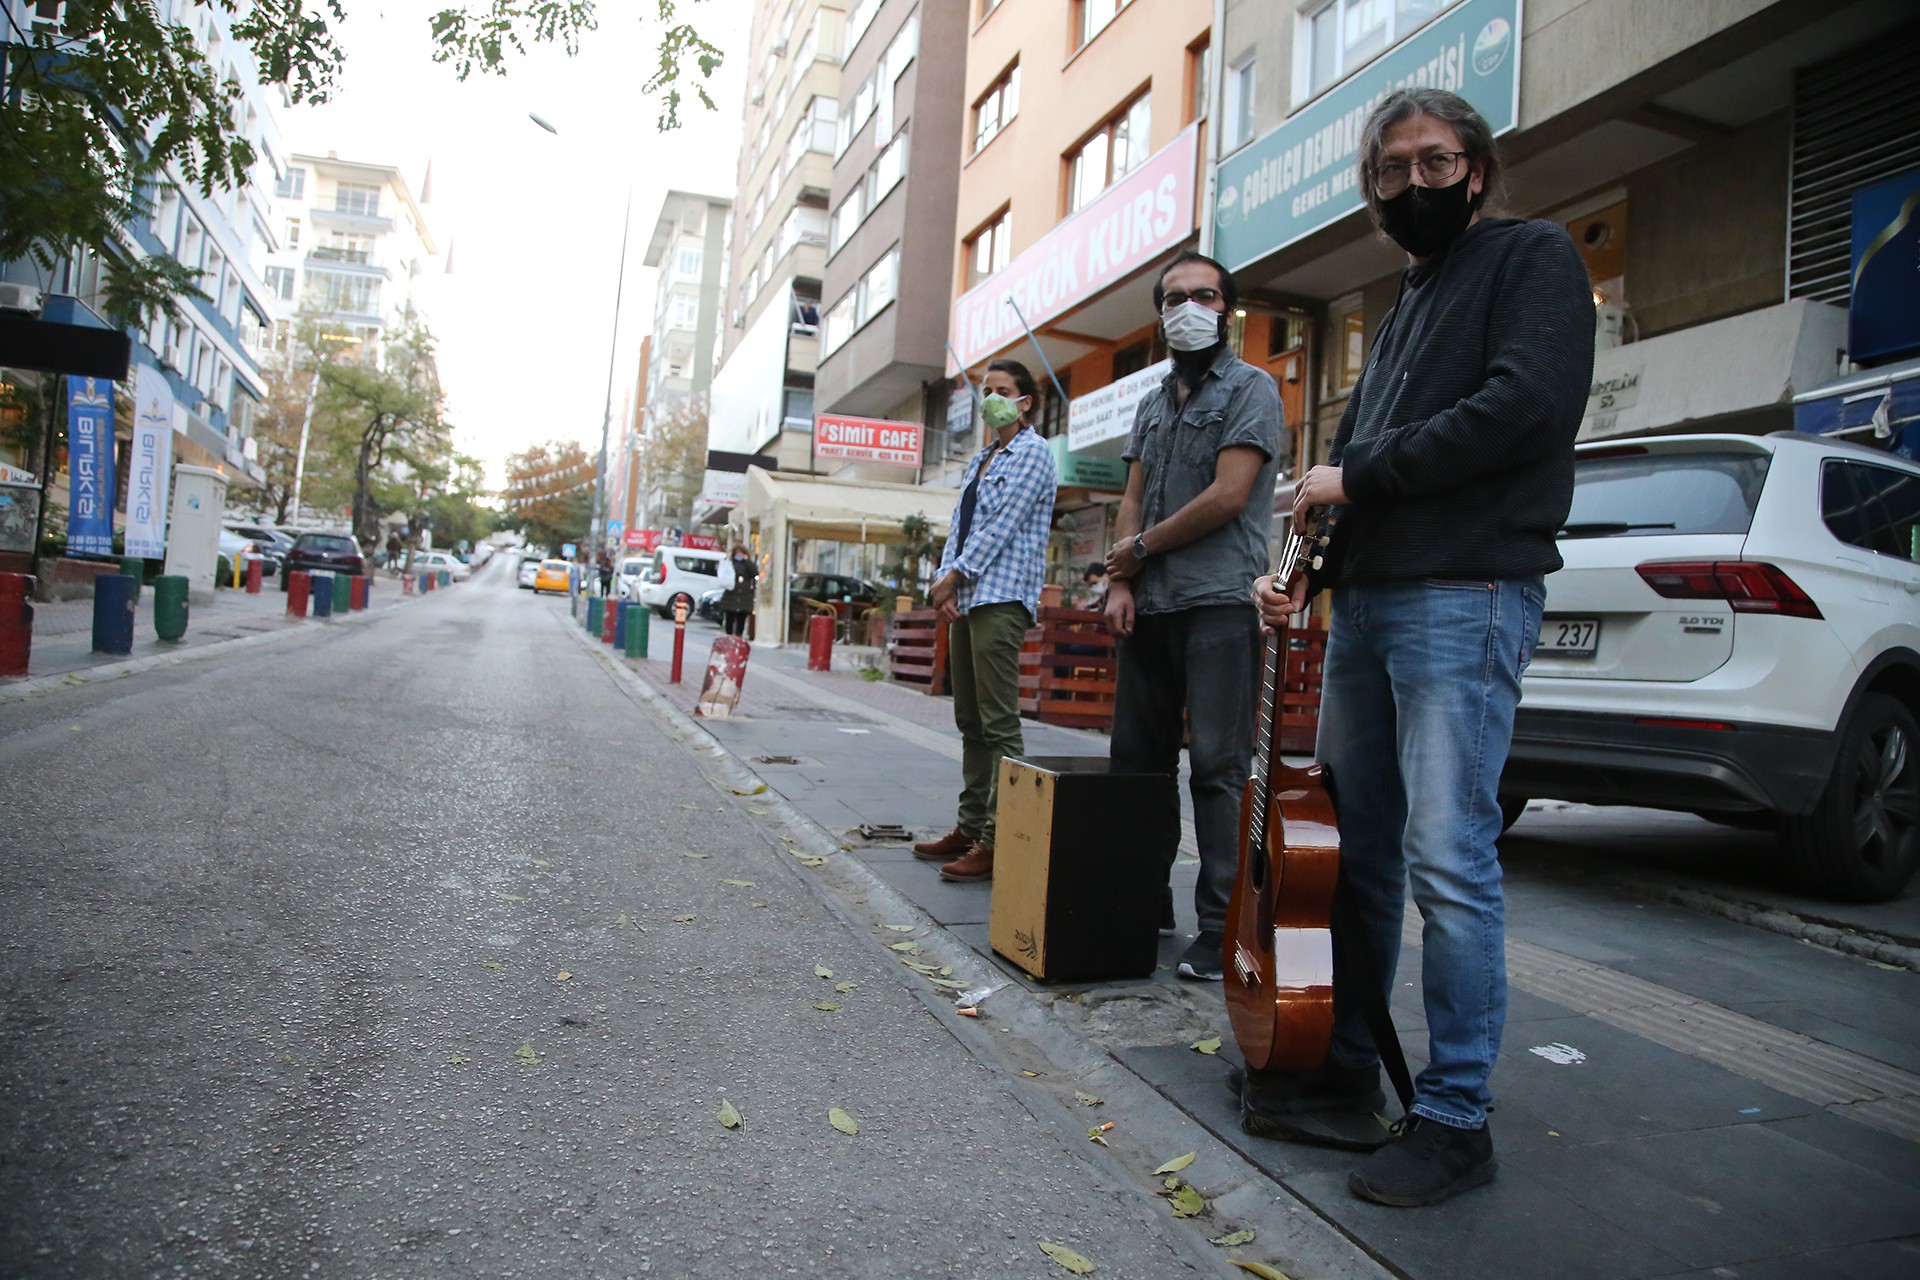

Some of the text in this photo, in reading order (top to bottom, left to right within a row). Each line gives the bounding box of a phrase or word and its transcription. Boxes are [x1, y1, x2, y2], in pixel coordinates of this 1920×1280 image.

[1242, 144, 1302, 221] ÇOĞULCU
[1291, 186, 1329, 218] GENEL
[969, 173, 1177, 354] KAREKÖK KURS
[828, 421, 876, 445] SİMİT
[1556, 623, 1594, 647] 237
[1702, 617, 1724, 626] TDI
